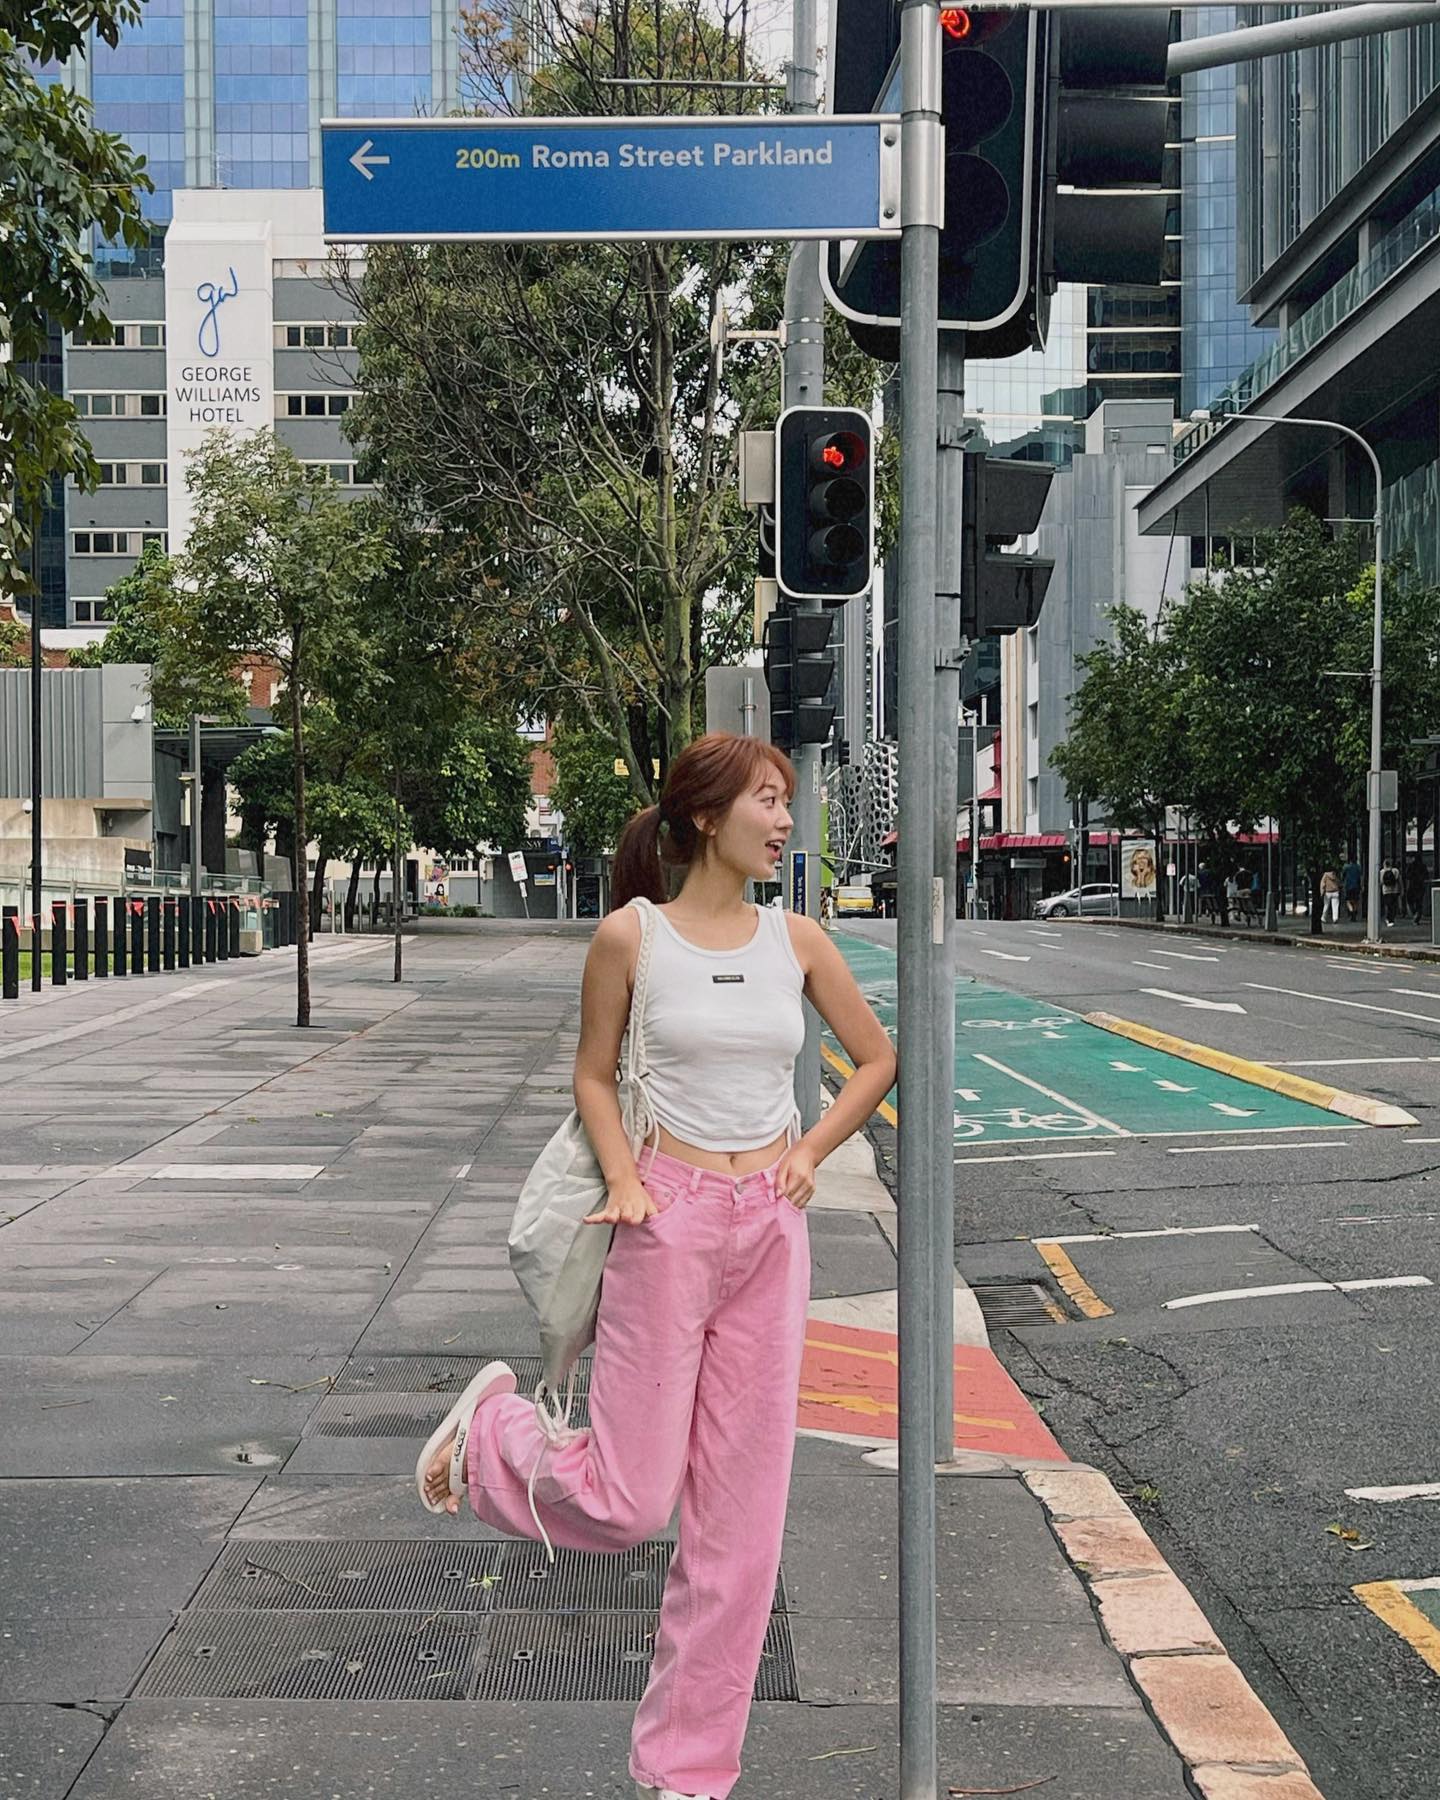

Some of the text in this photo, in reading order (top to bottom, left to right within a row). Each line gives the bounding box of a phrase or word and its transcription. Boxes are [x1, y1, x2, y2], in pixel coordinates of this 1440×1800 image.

[455, 140, 833, 169] 200m Roma Street Parkland
[181, 366, 253, 382] GEORGE
[175, 387, 261, 402] WILLIAMS
[189, 407, 245, 423] HOTEL
